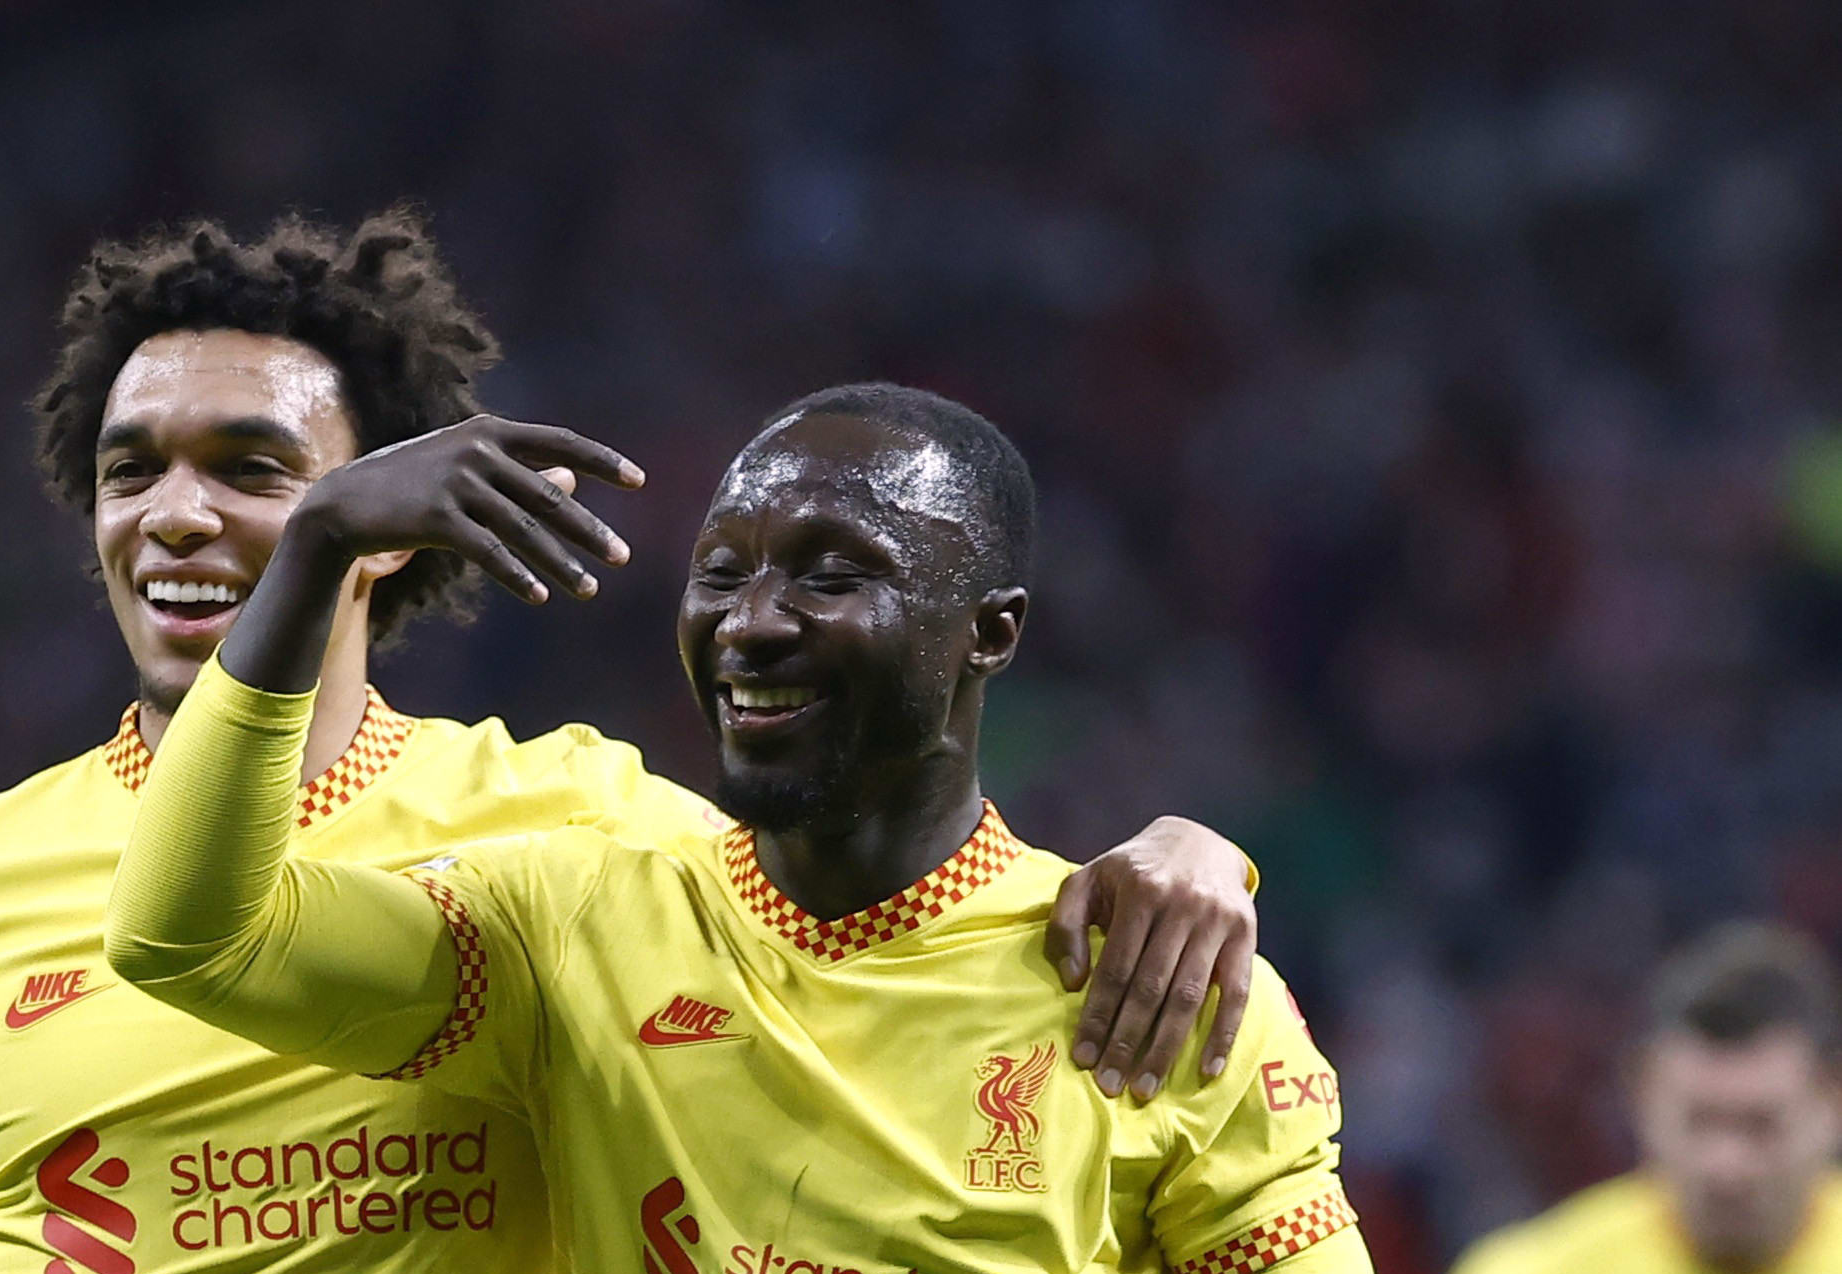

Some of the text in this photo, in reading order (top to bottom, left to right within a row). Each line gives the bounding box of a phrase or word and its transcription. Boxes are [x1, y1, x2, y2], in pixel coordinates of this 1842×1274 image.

[21, 968, 87, 1004] NIKE
[659, 995, 733, 1034] NIKE
[1261, 1060, 1340, 1120] Exp
[169, 1123, 488, 1196] standard
[172, 1180, 496, 1251] chartered
